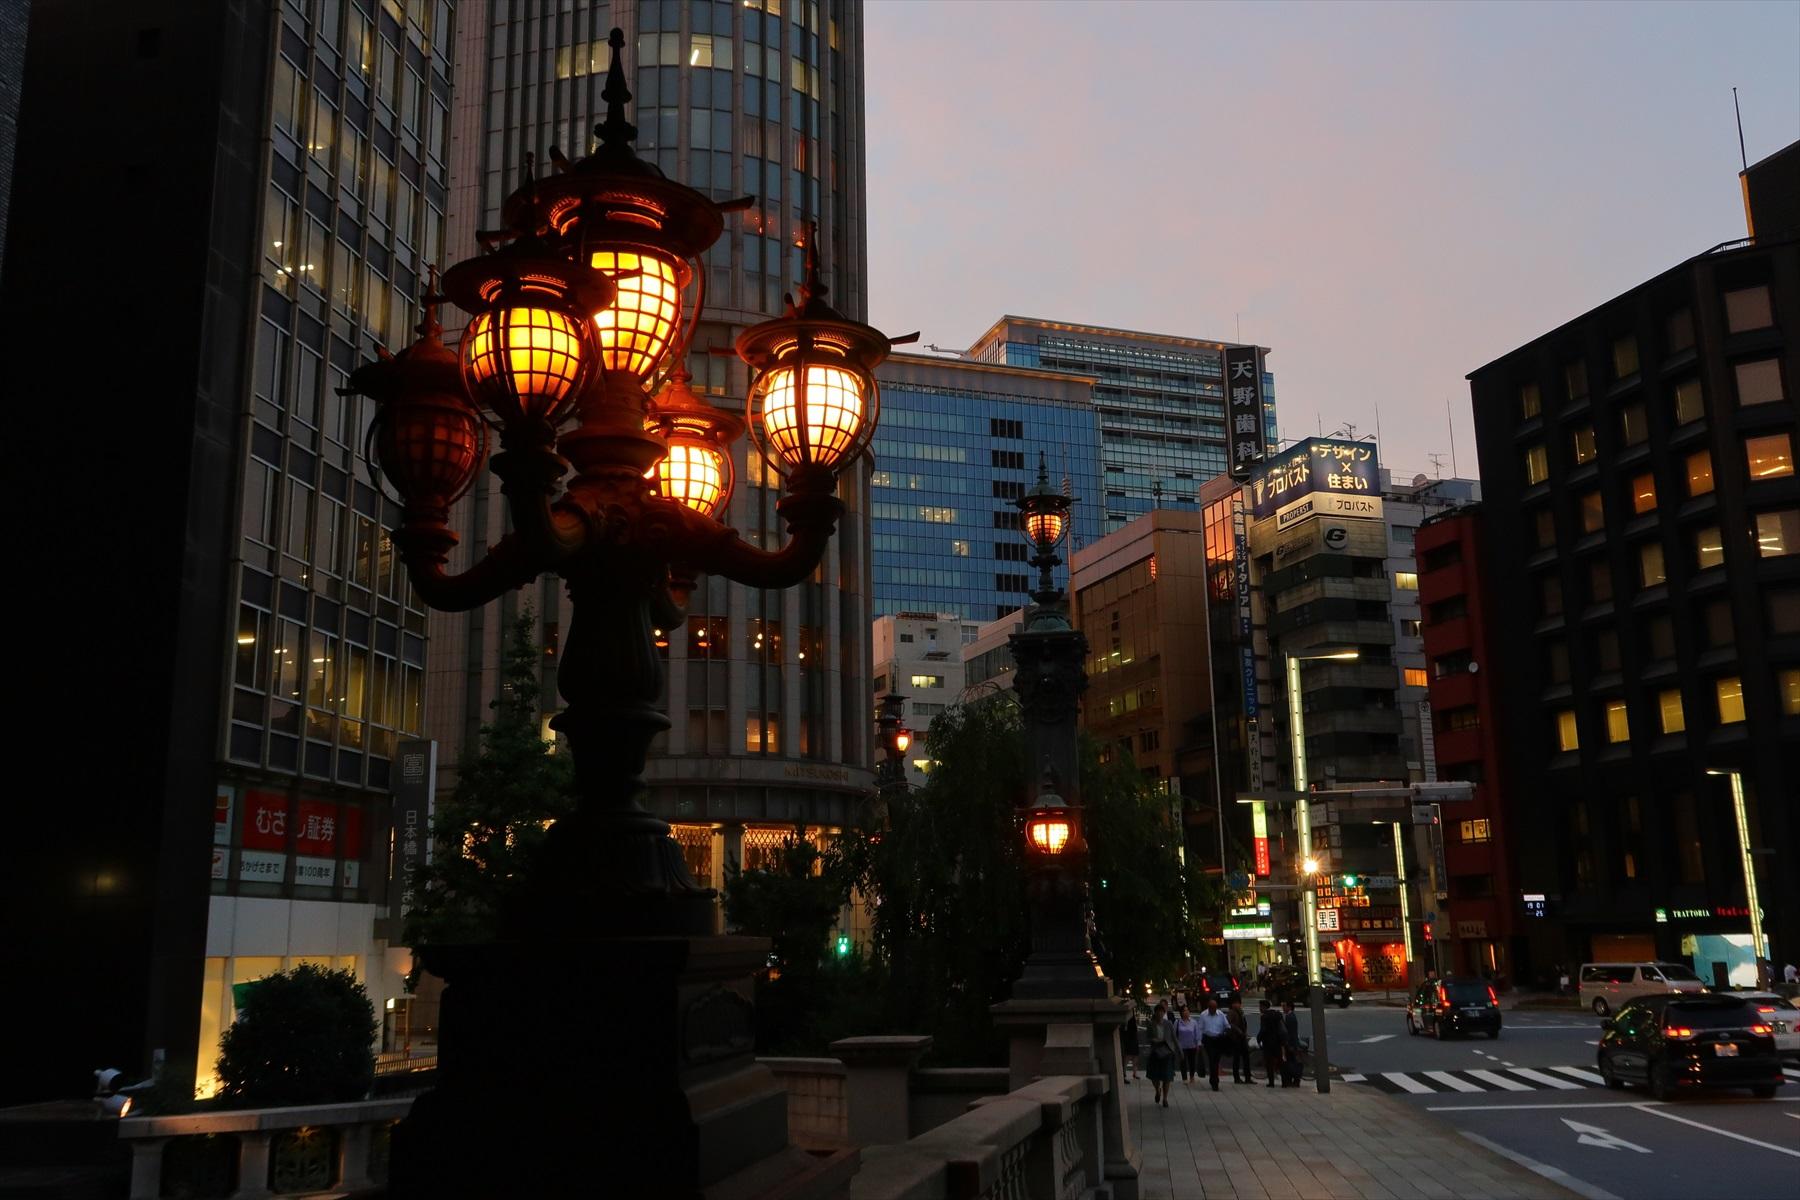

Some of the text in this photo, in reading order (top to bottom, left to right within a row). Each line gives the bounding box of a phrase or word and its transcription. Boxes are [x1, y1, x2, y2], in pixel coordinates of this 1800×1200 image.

[1231, 360, 1259, 461] 天野歯科
[1319, 444, 1371, 461] デザイン
[1327, 474, 1368, 490] 住まい
[1282, 503, 1310, 523] PROPERST
[1672, 909, 1711, 918] TRATTORIA
